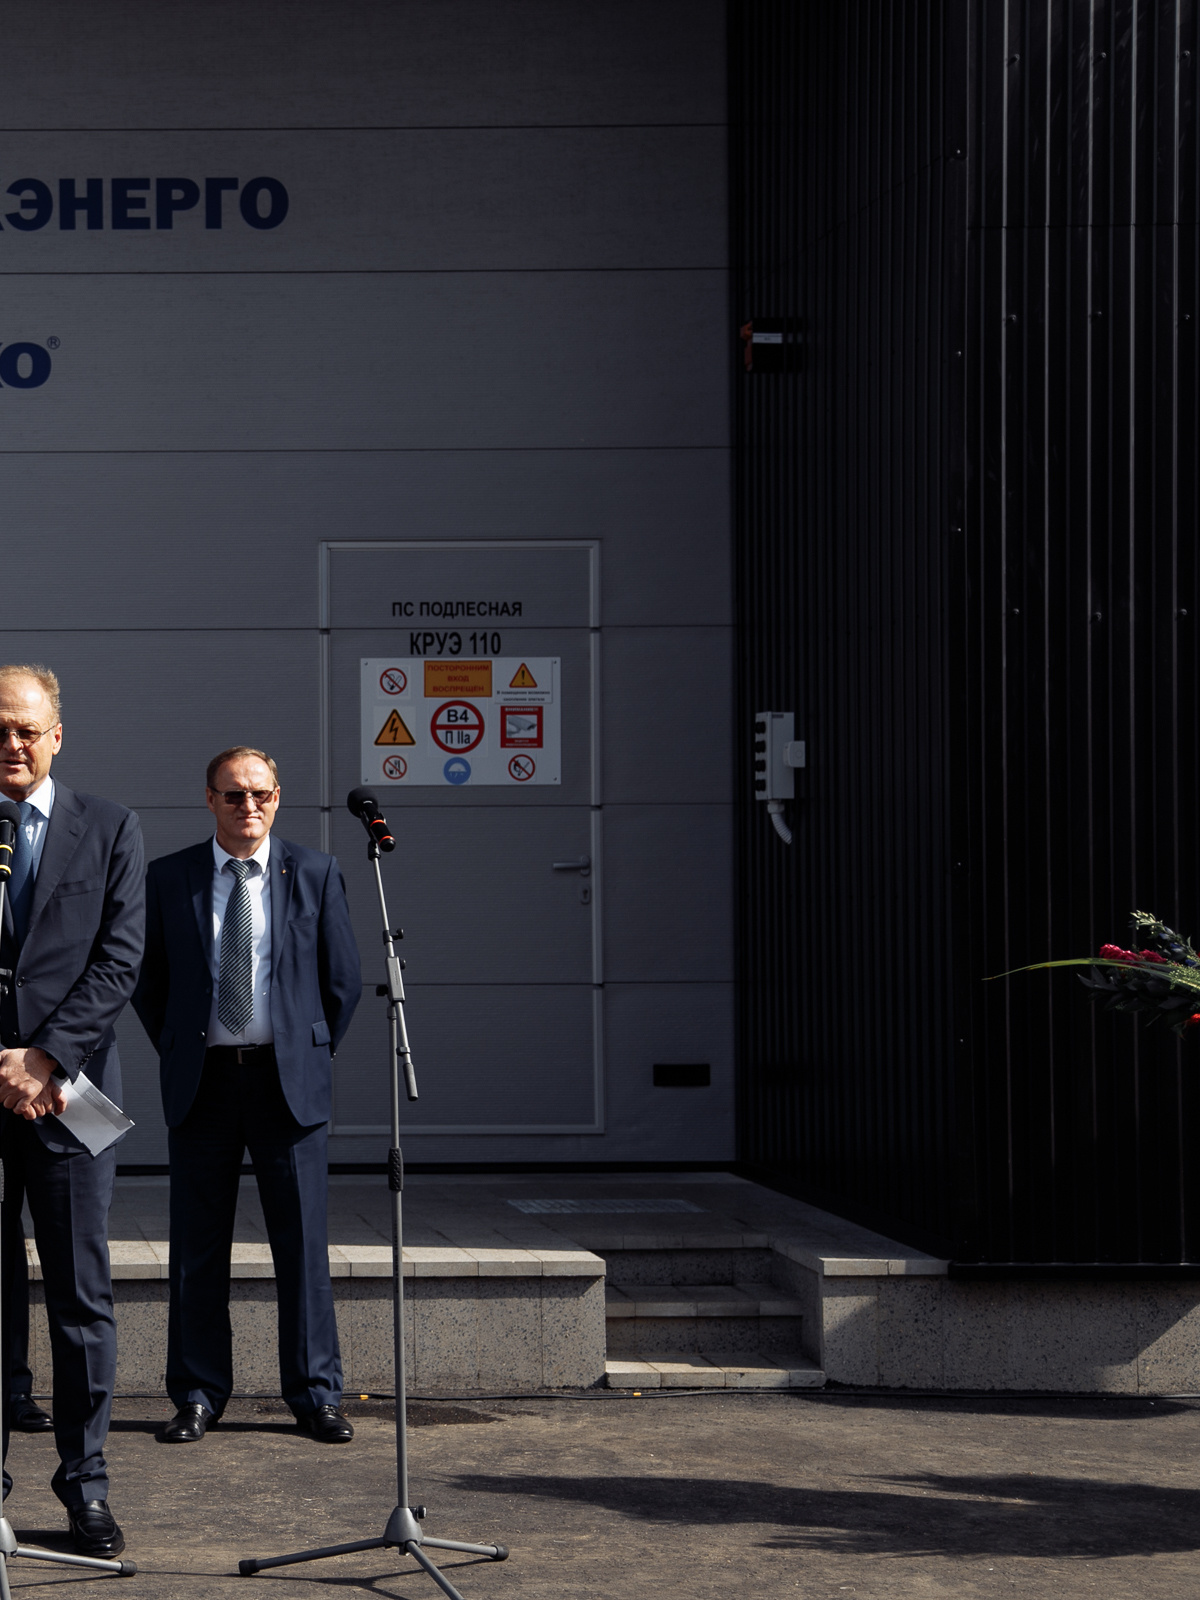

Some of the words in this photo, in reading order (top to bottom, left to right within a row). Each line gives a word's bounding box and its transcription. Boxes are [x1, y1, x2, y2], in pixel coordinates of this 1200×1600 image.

[391, 601, 415, 617] ПС
[419, 601, 523, 619] ПОДЛЕСНАЯ
[409, 631, 463, 656] КРУЭ
[469, 631, 502, 656] 110
[427, 664, 490, 672] ПОСТОРОННИМ
[447, 675, 470, 683] ВХОД
[432, 685, 485, 693] ВОСПРЕЩЕН
[446, 709, 470, 723] В4
